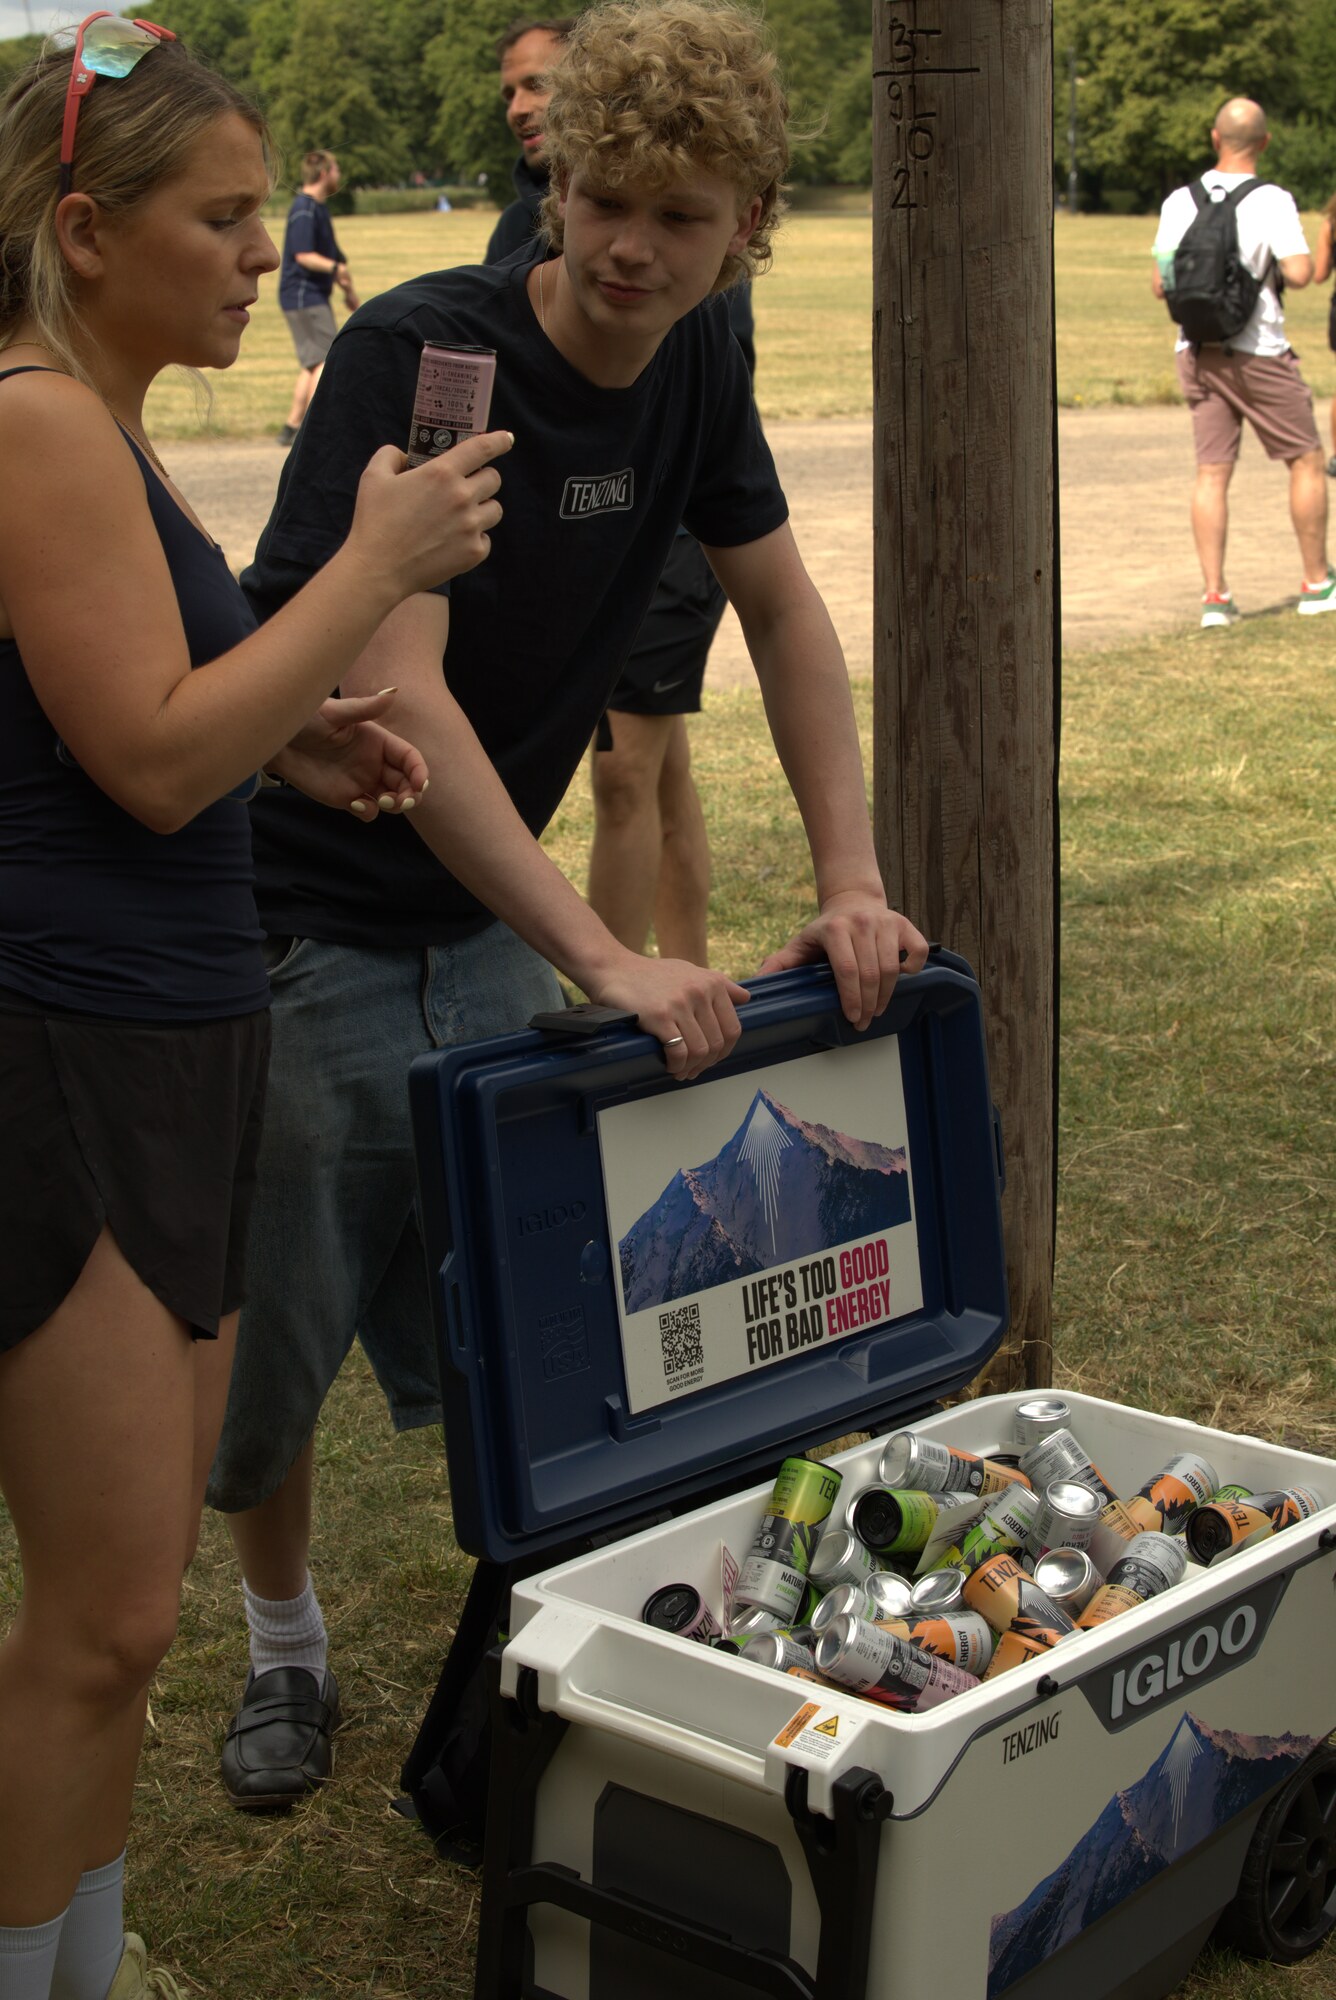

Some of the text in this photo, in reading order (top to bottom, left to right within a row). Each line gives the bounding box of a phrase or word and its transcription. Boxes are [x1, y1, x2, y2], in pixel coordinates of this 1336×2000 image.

[570, 474, 628, 512] TENZING
[517, 1200, 587, 1238] IGLOO
[742, 1238, 890, 1324] LIFE'S TOO GOOD
[746, 1278, 890, 1365] FOR BAD ENERGY
[666, 1366, 704, 1386] SCAN FOR MORE
[669, 1374, 703, 1392] GOOD ENERGY
[1001, 1513, 1029, 1540] ENERGY
[957, 1630, 969, 1663] ENERGY
[1110, 1604, 1257, 1720] IGLOO
[1002, 1710, 1060, 1765] TENZING
